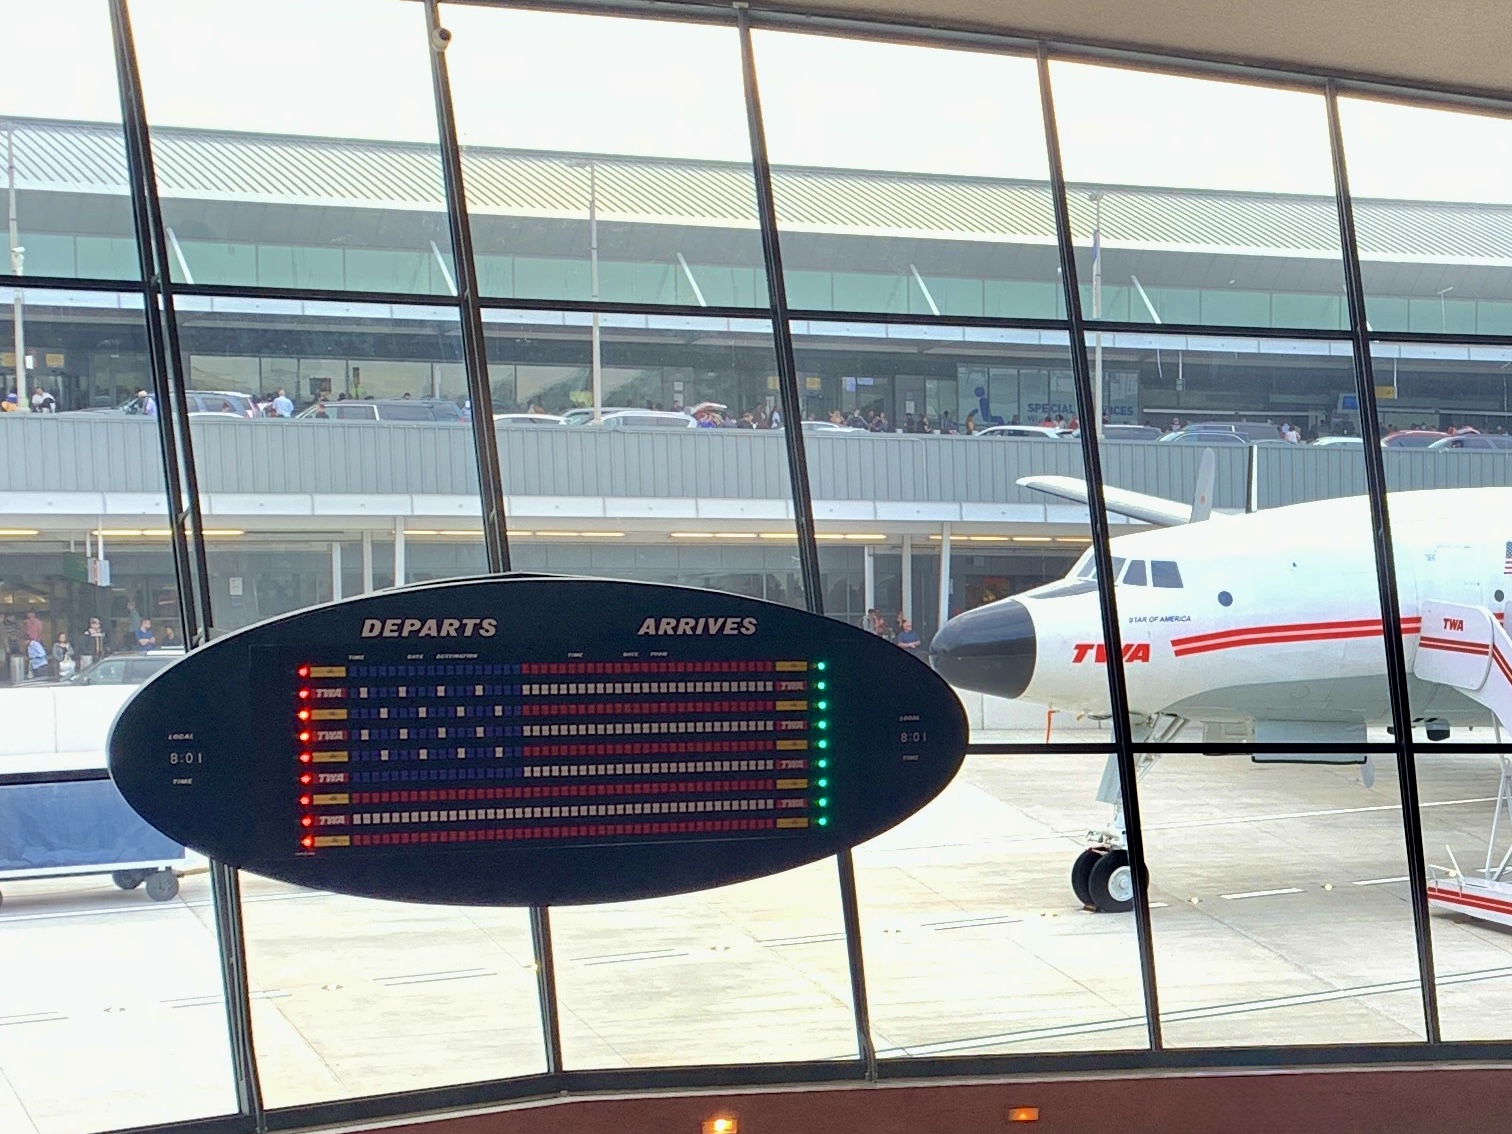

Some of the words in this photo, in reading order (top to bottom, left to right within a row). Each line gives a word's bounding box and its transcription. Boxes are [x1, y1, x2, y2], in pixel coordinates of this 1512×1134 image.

[1027, 403, 1075, 415] SPECIAL
[1160, 615, 1191, 623] AMERICA
[361, 618, 498, 638] DEPARTS
[637, 617, 758, 636] ARRIVES
[1443, 618, 1464, 632] TWA
[316, 688, 342, 698] TWA
[317, 731, 344, 741] TWA
[900, 732, 927, 743] 8:01
[170, 752, 202, 765] 8:01
[318, 773, 345, 783] TWA
[319, 815, 346, 825] TWA
